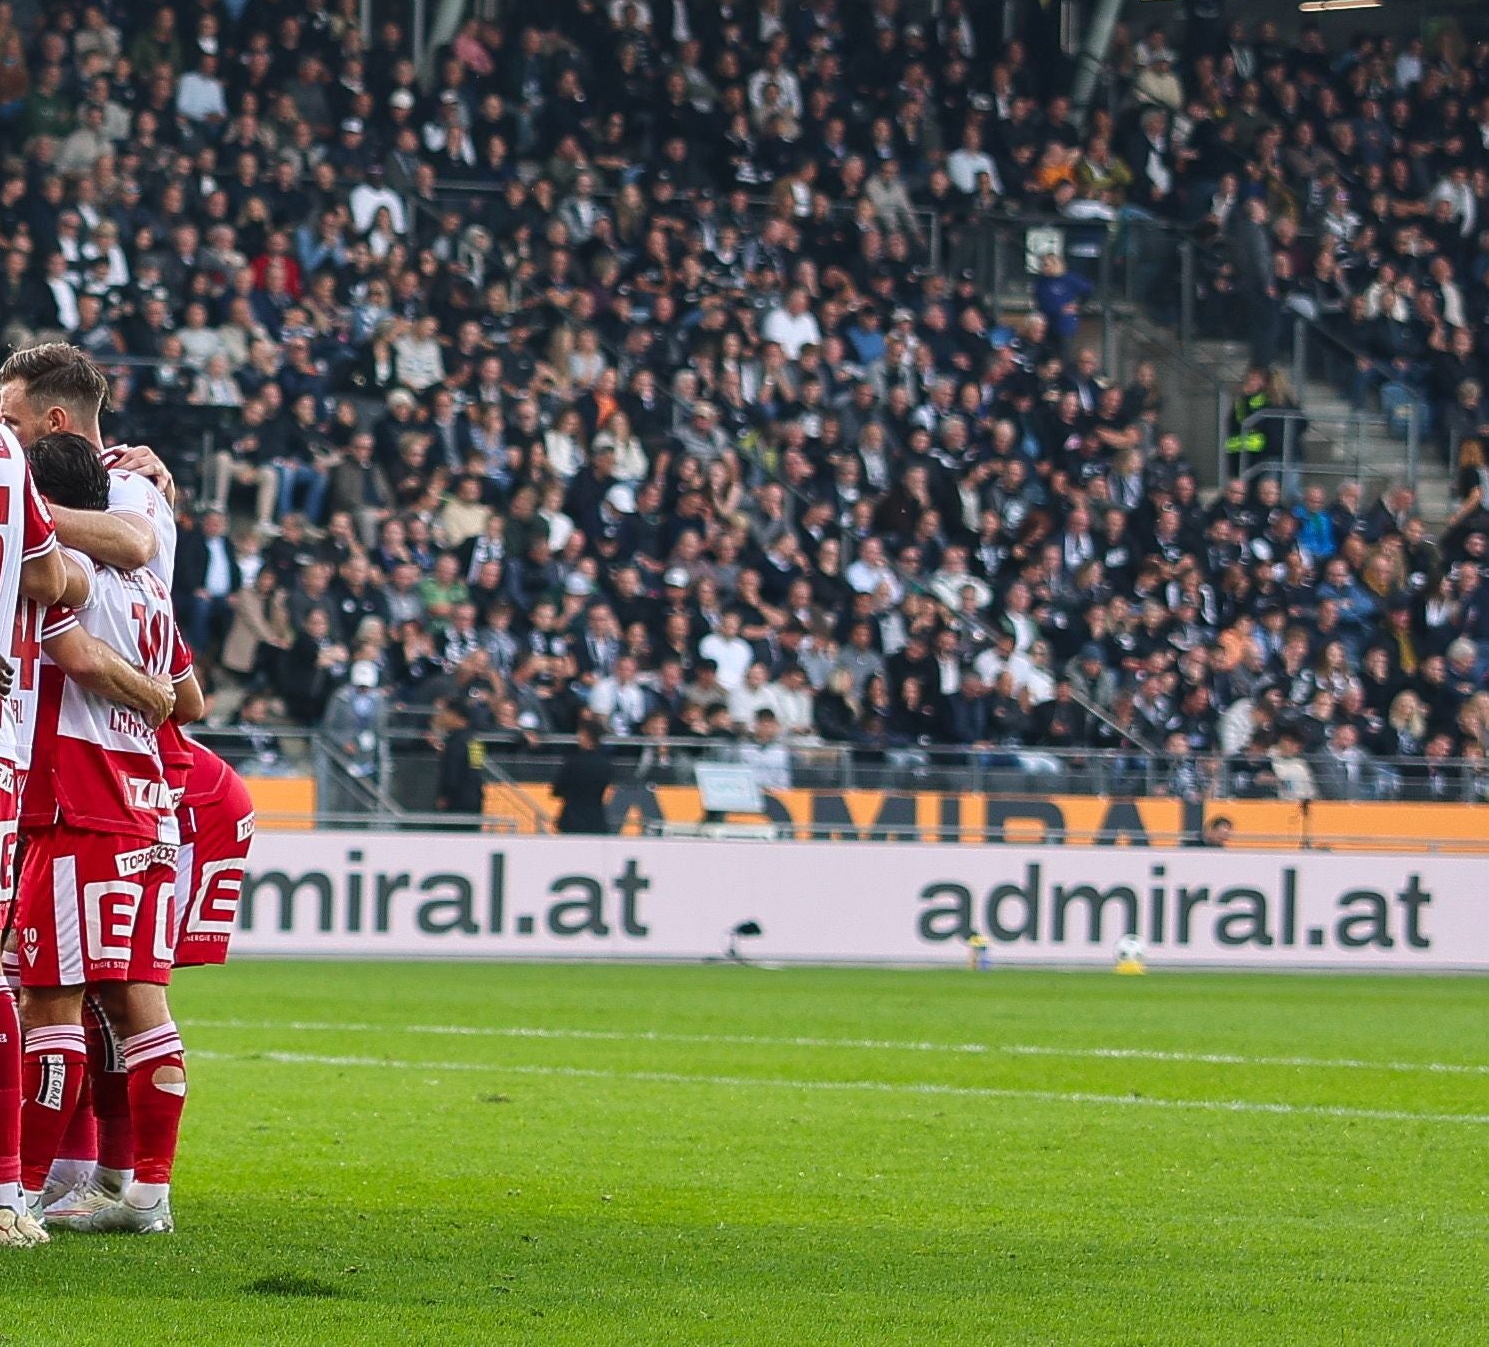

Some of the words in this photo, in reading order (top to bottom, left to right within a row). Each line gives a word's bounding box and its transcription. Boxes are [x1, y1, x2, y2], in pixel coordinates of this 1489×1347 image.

[607, 784, 1207, 848] AMIRA
[237, 850, 650, 937] miral.at
[917, 862, 1432, 950] admiral.at
[23, 927, 37, 943] 10
[46, 1078, 63, 1111] GRAZ
